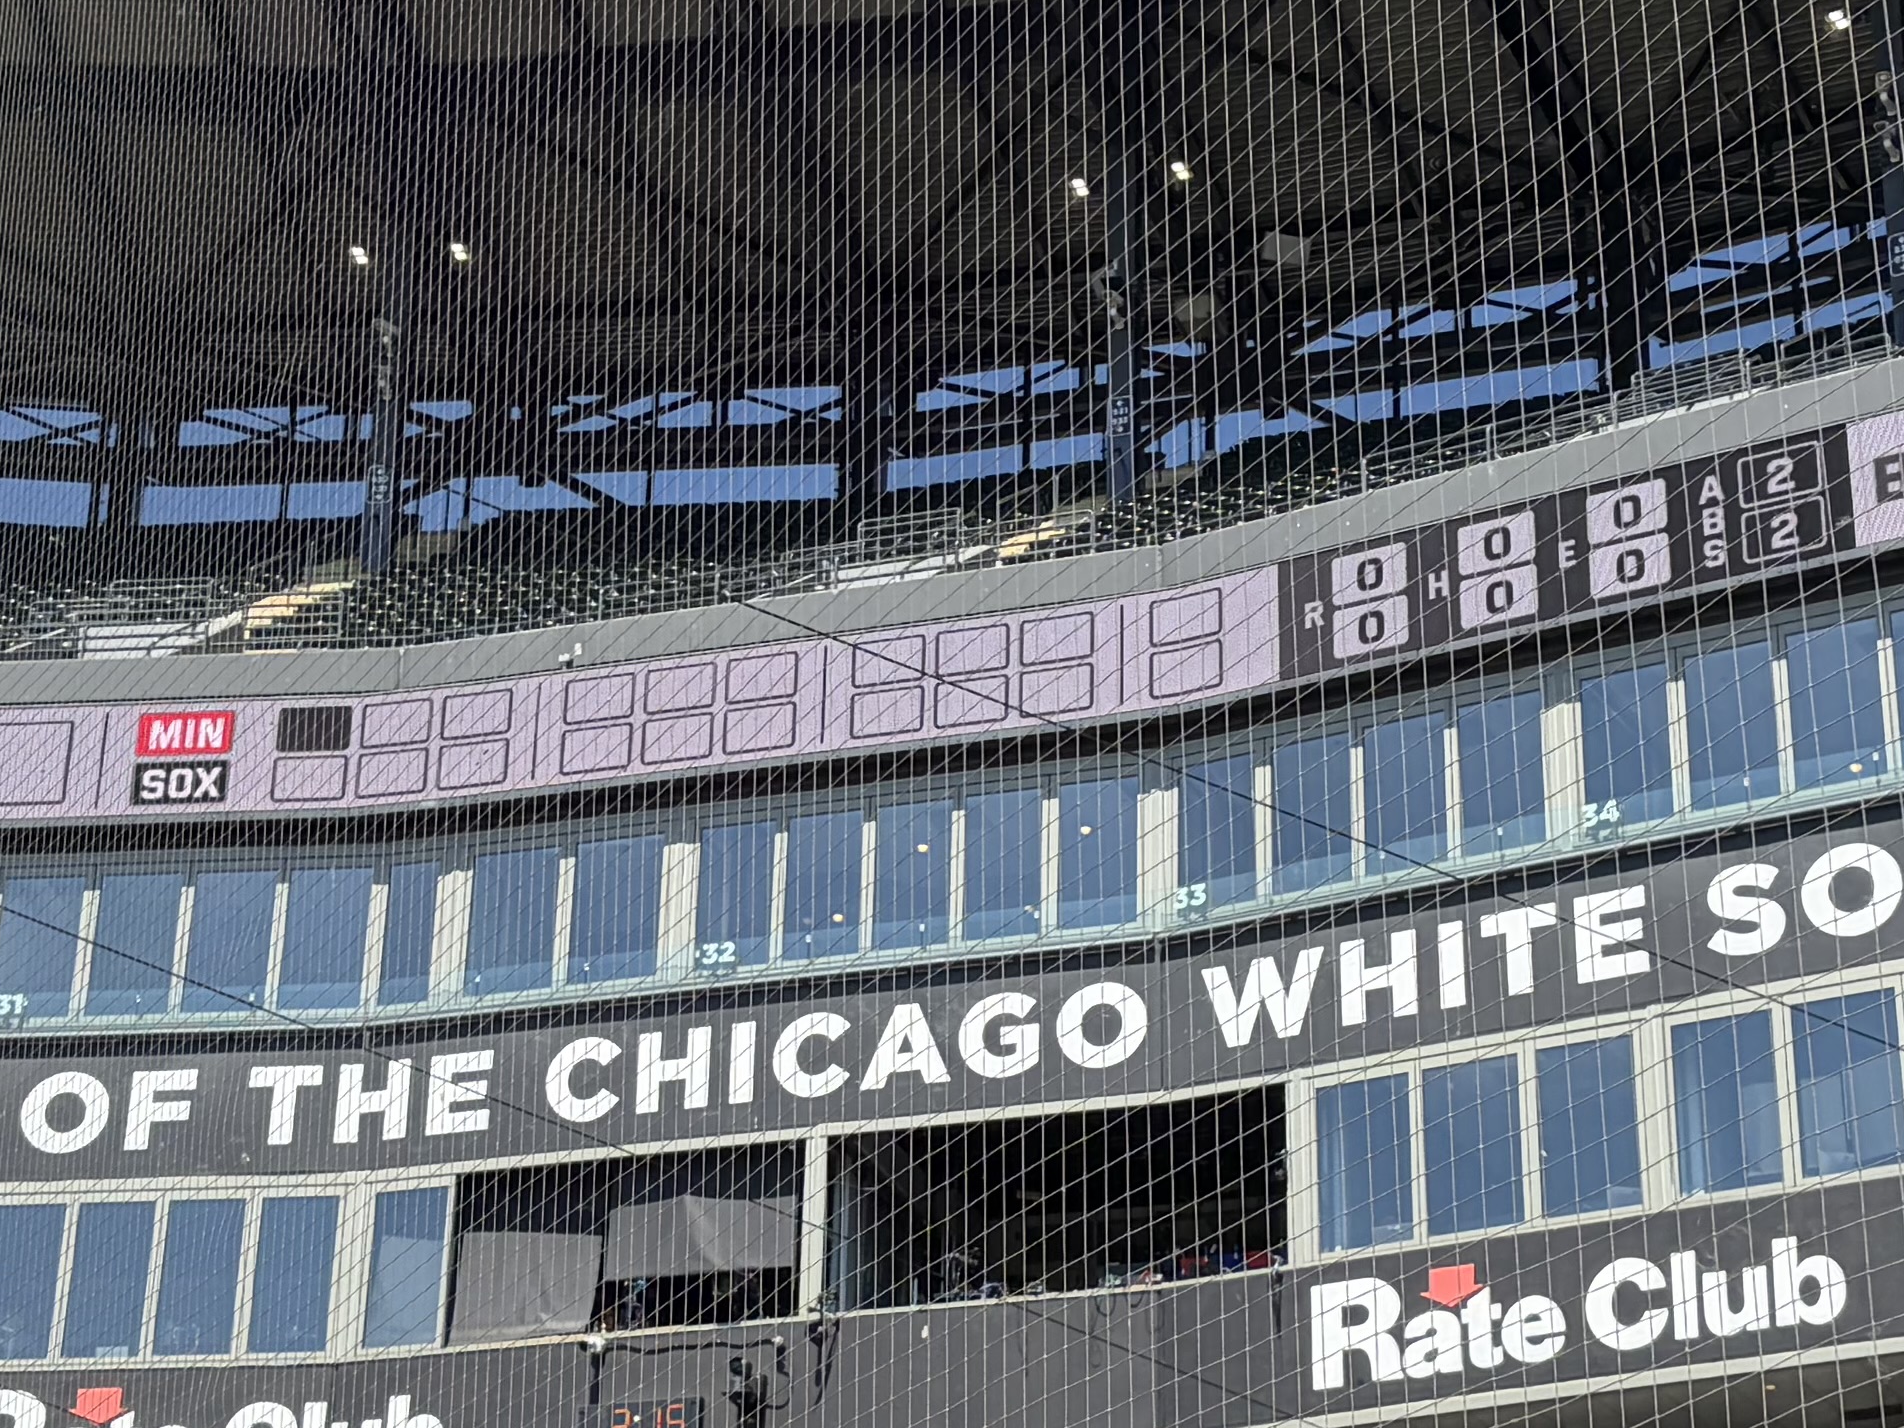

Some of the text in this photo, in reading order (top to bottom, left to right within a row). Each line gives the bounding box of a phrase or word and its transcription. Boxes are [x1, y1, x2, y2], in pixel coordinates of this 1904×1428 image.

[1765, 456, 1794, 495] 2
[1612, 495, 1643, 529] 0
[1485, 526, 1511, 562] 0
[1770, 512, 1798, 549] 2
[1357, 557, 1383, 591] 0
[1558, 540, 1645, 583] E 0
[1428, 572, 1513, 615] H 0
[1303, 601, 1385, 643] R 0
[147, 718, 224, 751] MIN
[139, 768, 223, 801] SOX
[1581, 800, 1620, 828] 34
[1172, 885, 1208, 910] 33
[700, 941, 737, 965] 32
[20, 1068, 198, 1154] OF
[248, 1049, 496, 1146] THE
[544, 980, 1148, 1124] CHICAGO
[1200, 886, 1652, 1048] WHITE
[1309, 1237, 1847, 1391] Rate Club
